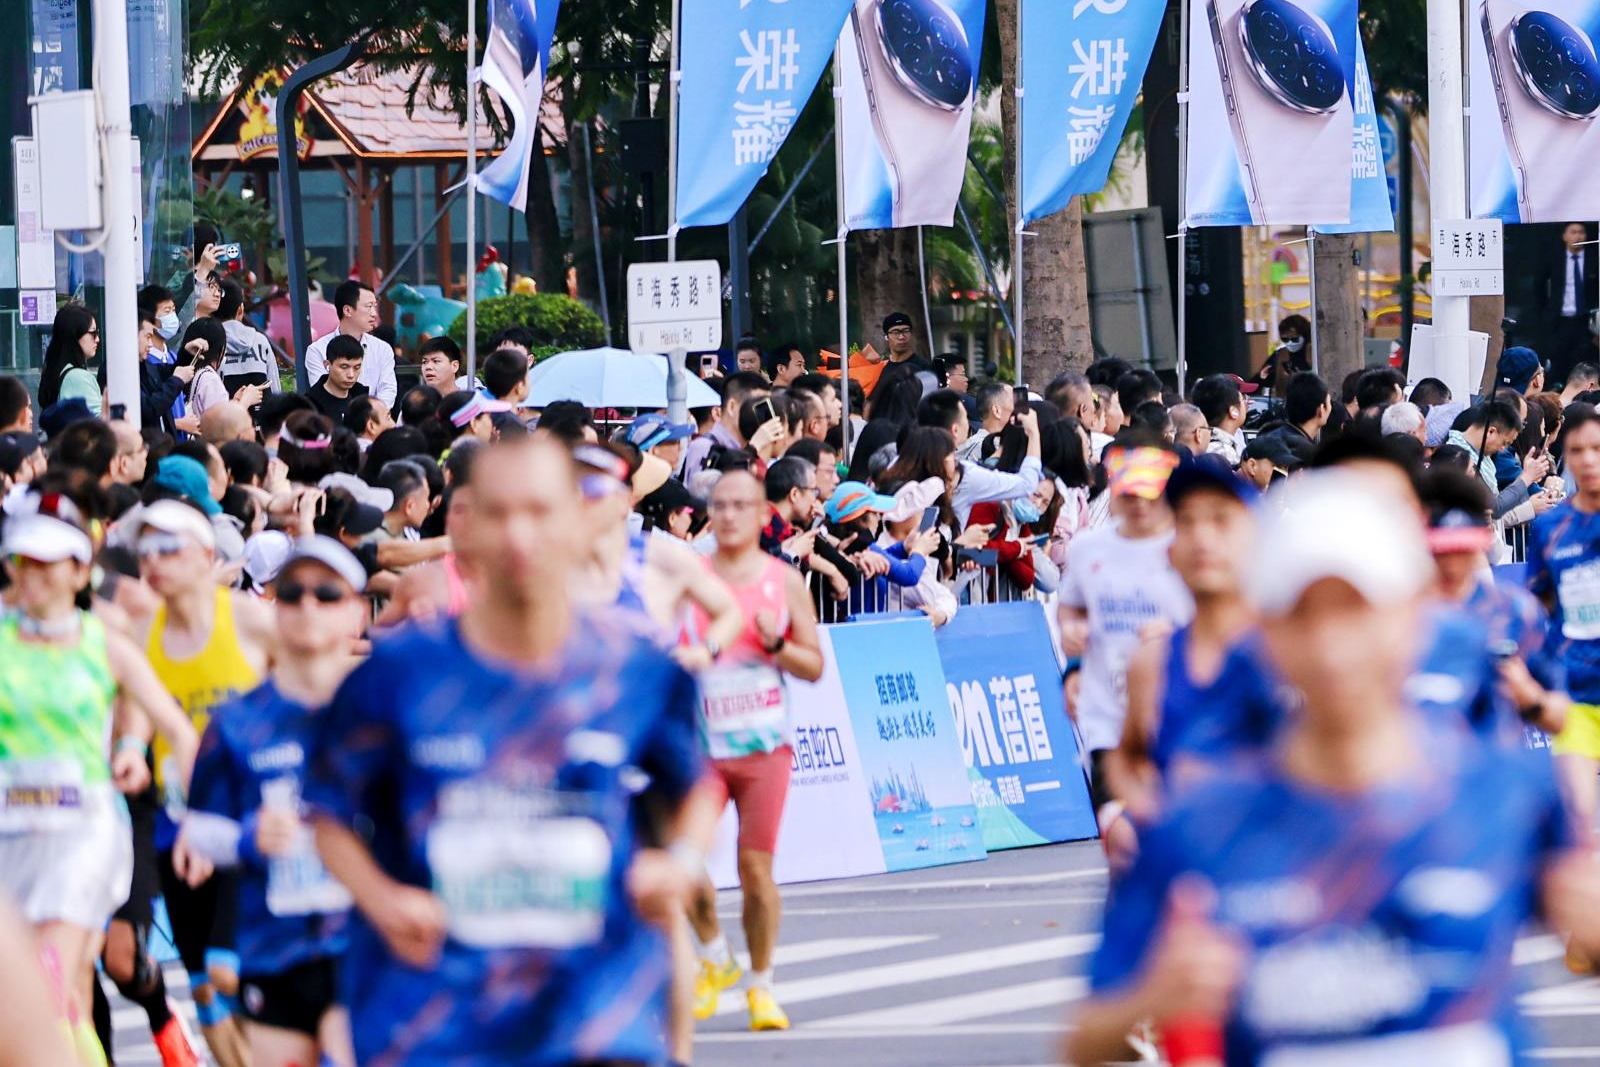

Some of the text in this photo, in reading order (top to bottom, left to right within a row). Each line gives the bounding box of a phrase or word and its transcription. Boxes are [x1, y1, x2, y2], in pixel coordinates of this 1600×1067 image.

[732, 29, 800, 166] 荣耀
[651, 275, 699, 310] 海秀路
